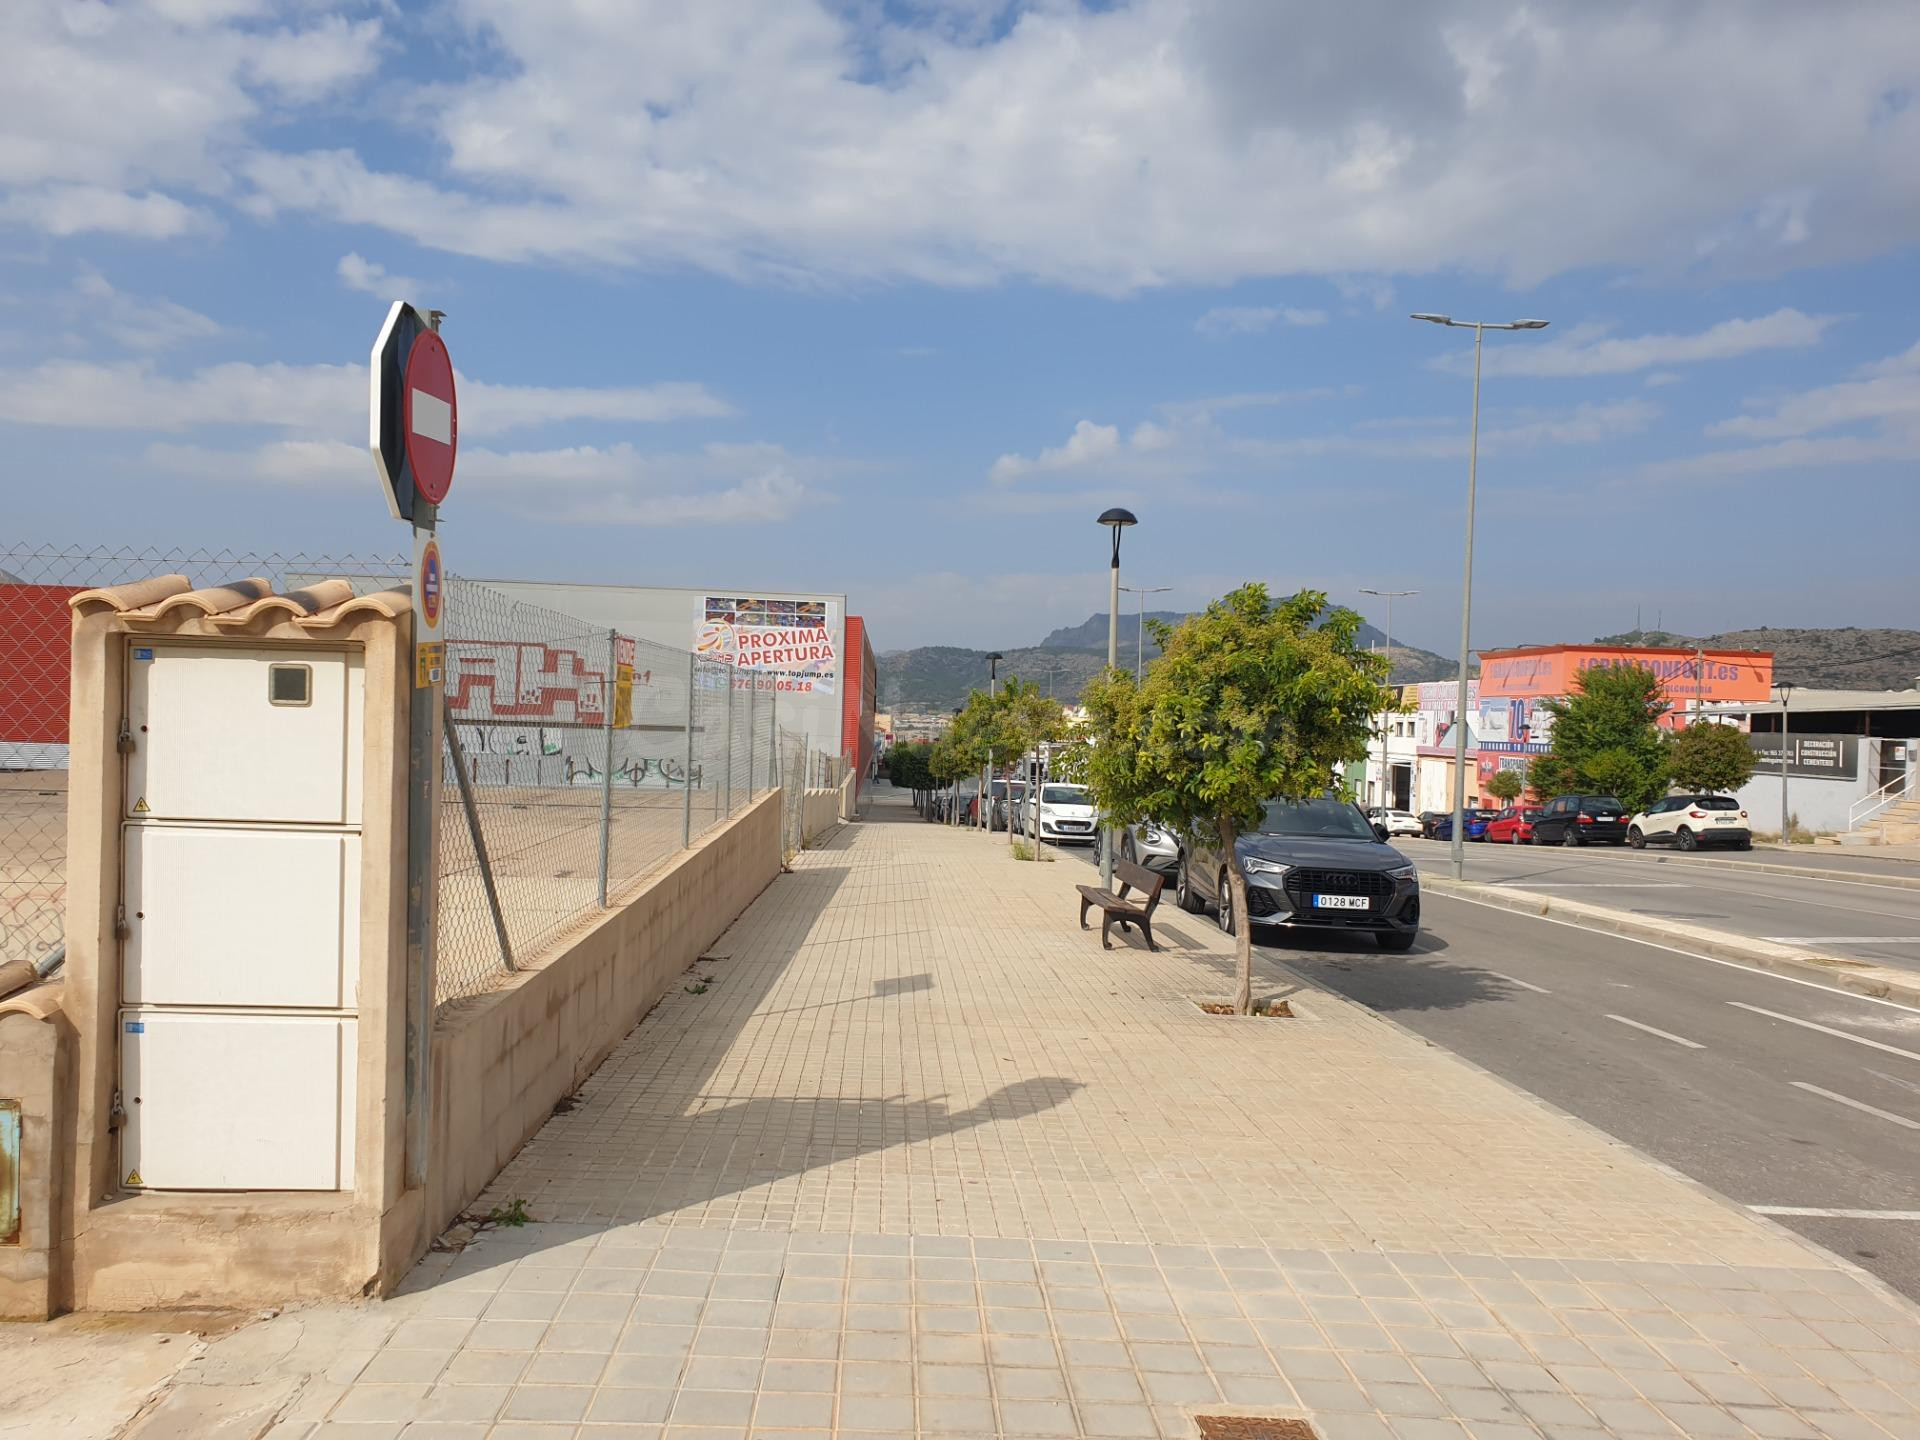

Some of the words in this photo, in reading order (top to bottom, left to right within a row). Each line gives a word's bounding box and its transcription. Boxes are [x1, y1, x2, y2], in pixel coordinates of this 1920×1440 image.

[738, 628, 829, 650] PROXIMA
[738, 645, 834, 666] APERTURA
[766, 670, 834, 679] www.topjump.es
[1320, 896, 1346, 906] 0128
[1349, 898, 1367, 908] MCF
